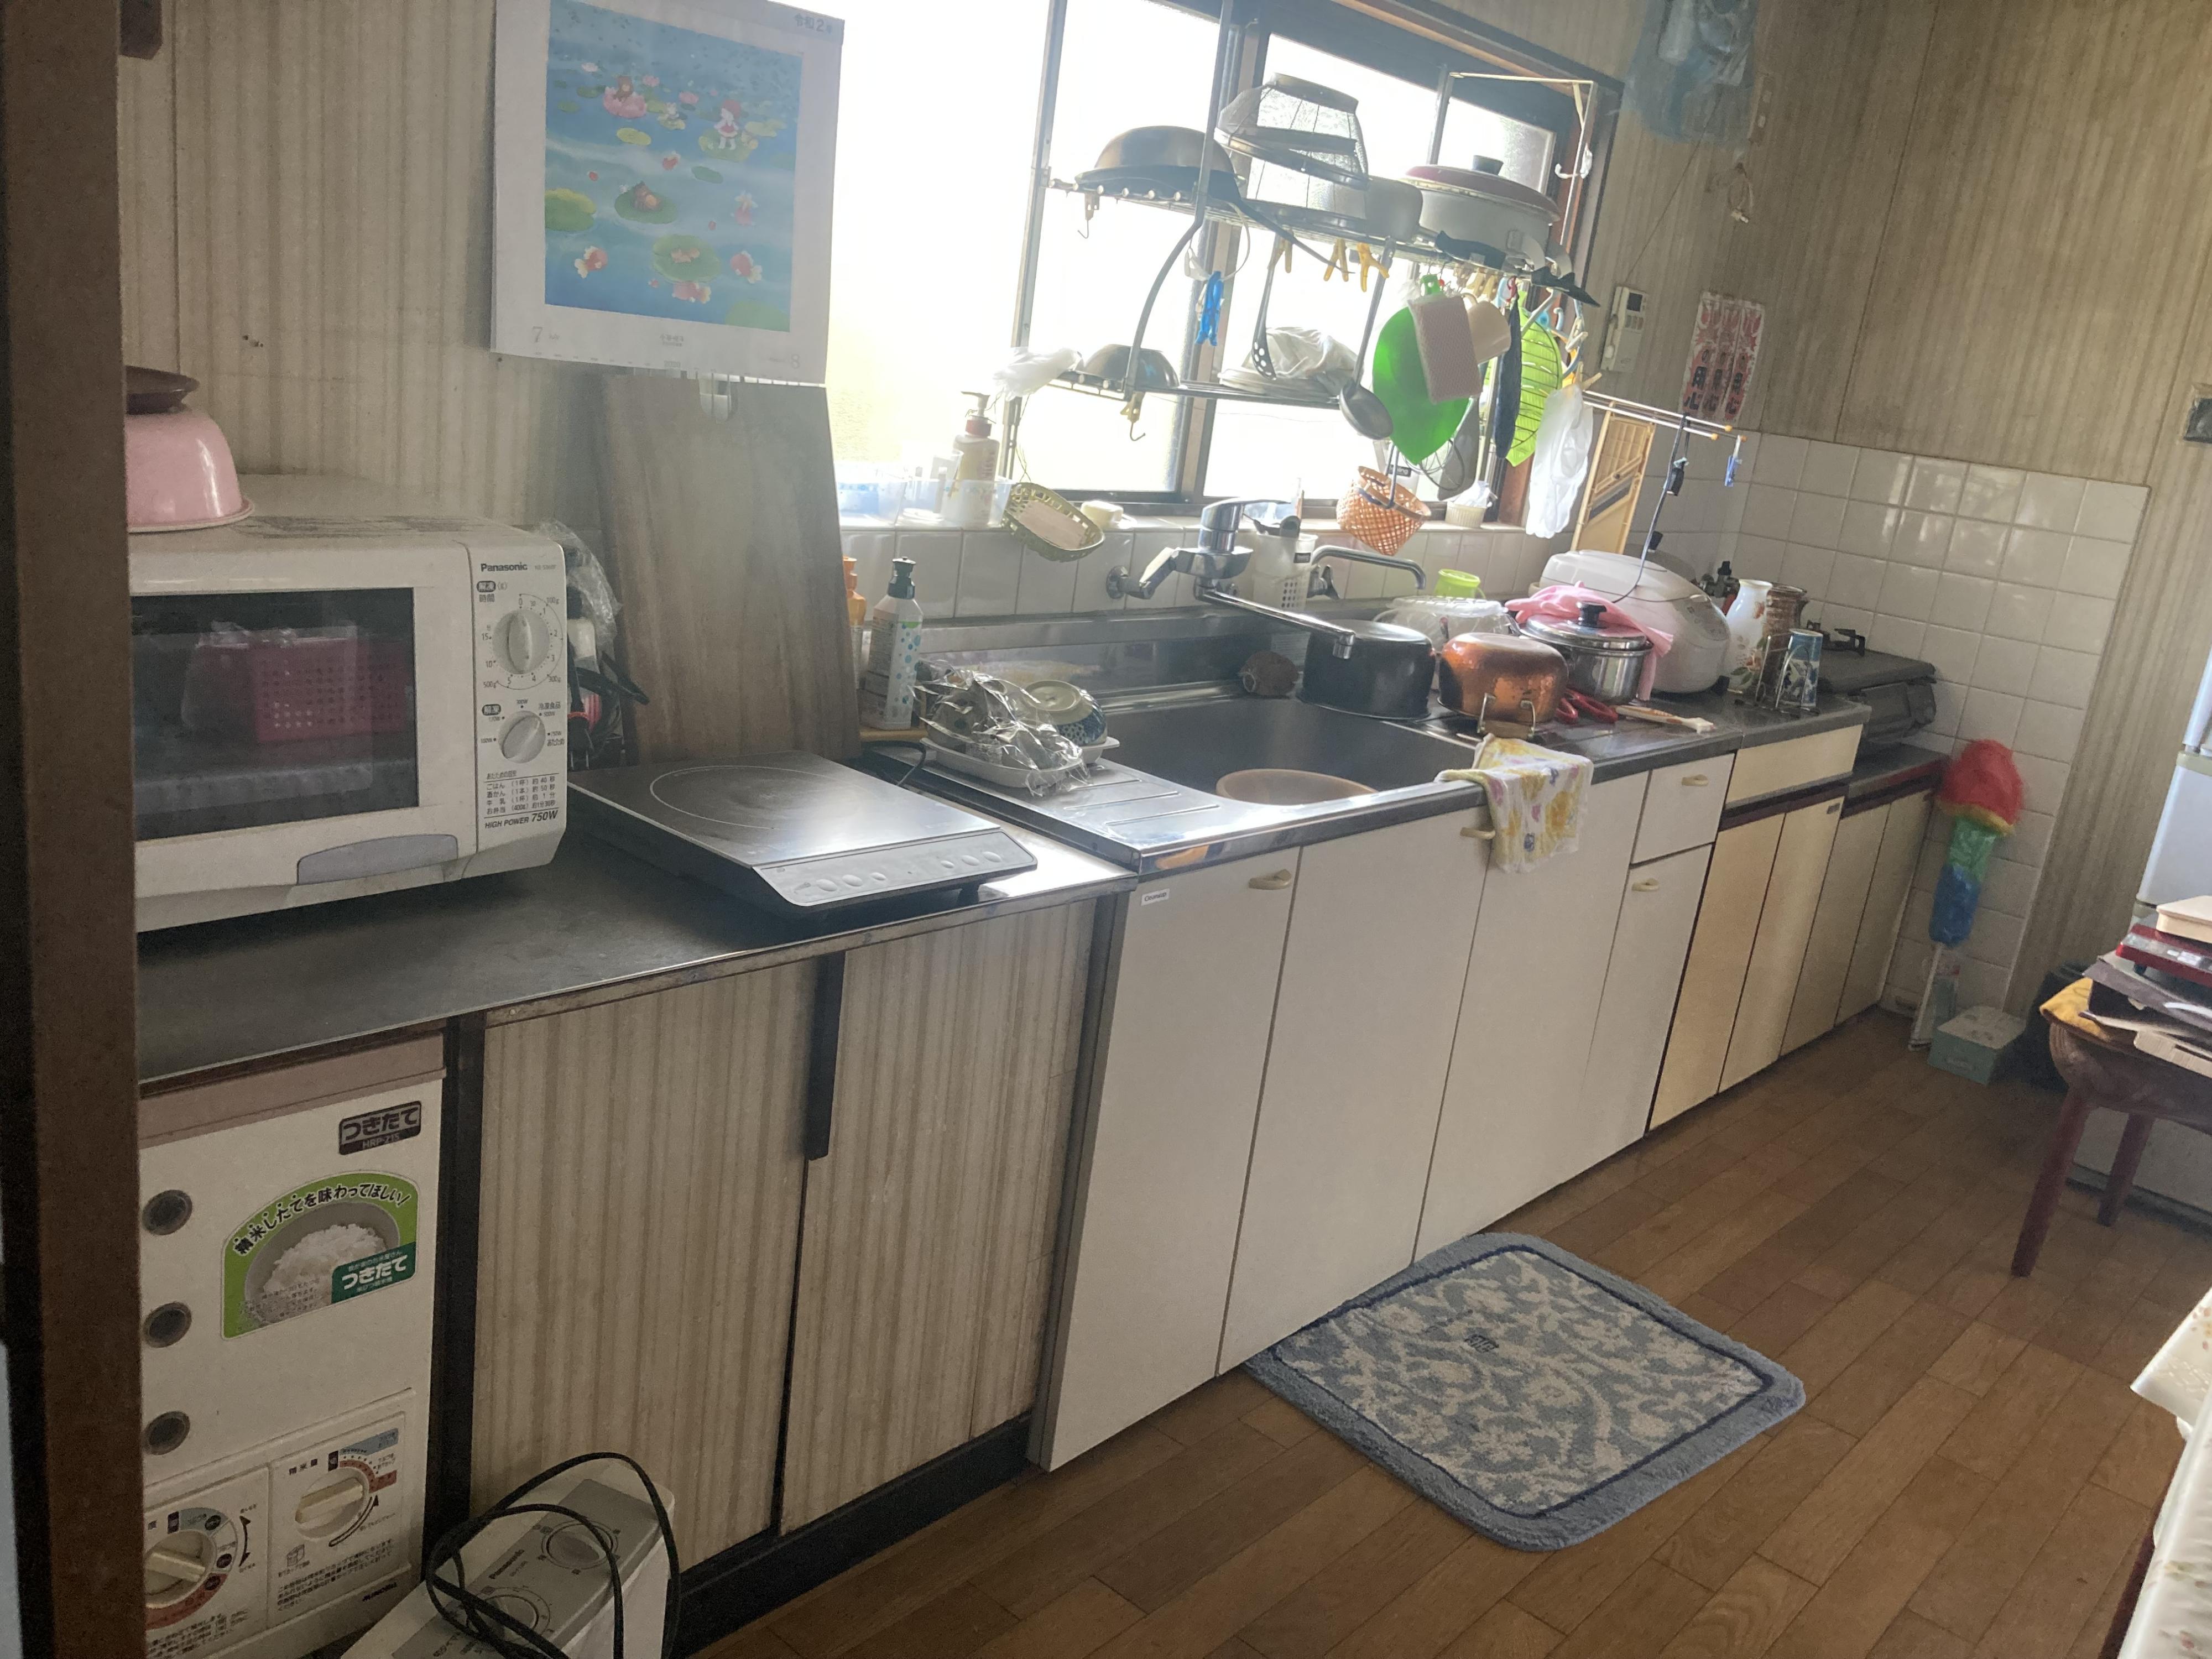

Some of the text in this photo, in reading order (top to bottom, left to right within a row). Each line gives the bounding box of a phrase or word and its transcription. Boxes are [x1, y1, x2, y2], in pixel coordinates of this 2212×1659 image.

[533, 326, 542, 342] 7
[791, 354, 800, 369] 8
[481, 562, 528, 572] Panasonic
[479, 593, 495, 602] 時間
[485, 810, 558, 829] HIGH POWER 750W
[343, 1107, 419, 1141] つきたて
[342, 1254, 408, 1290] つきたて
